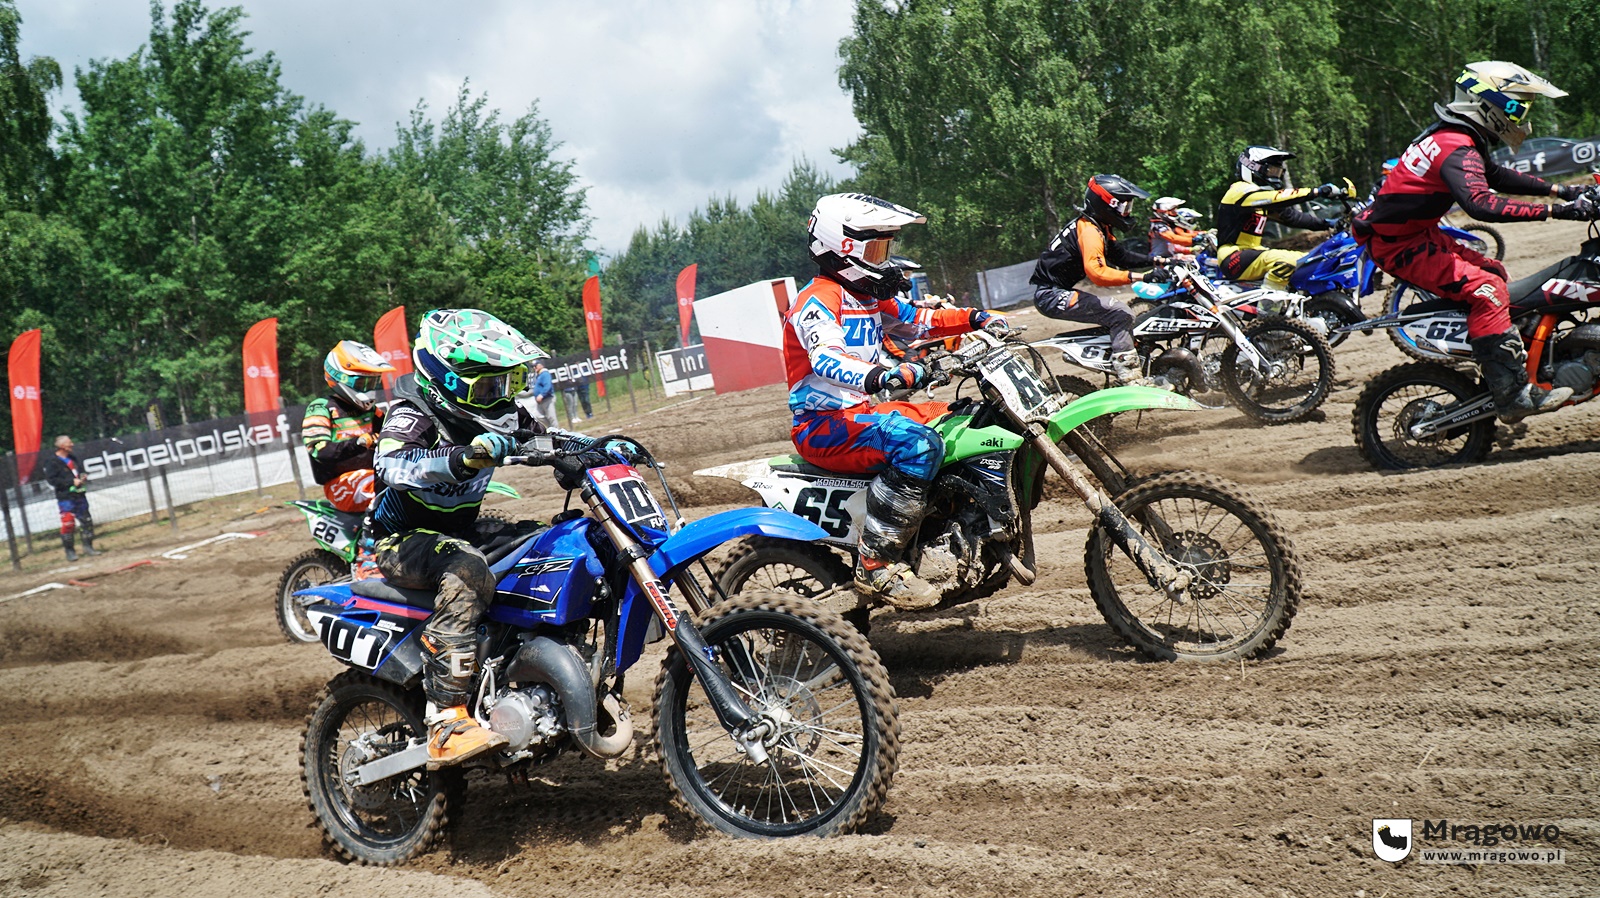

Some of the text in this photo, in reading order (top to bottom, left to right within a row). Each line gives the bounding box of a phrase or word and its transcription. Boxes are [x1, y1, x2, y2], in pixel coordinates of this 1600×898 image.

[803, 309, 821, 322] AK
[1149, 318, 1214, 329] FALCON
[792, 487, 853, 539] 65
[313, 521, 340, 545] 26
[318, 614, 389, 668] 107
